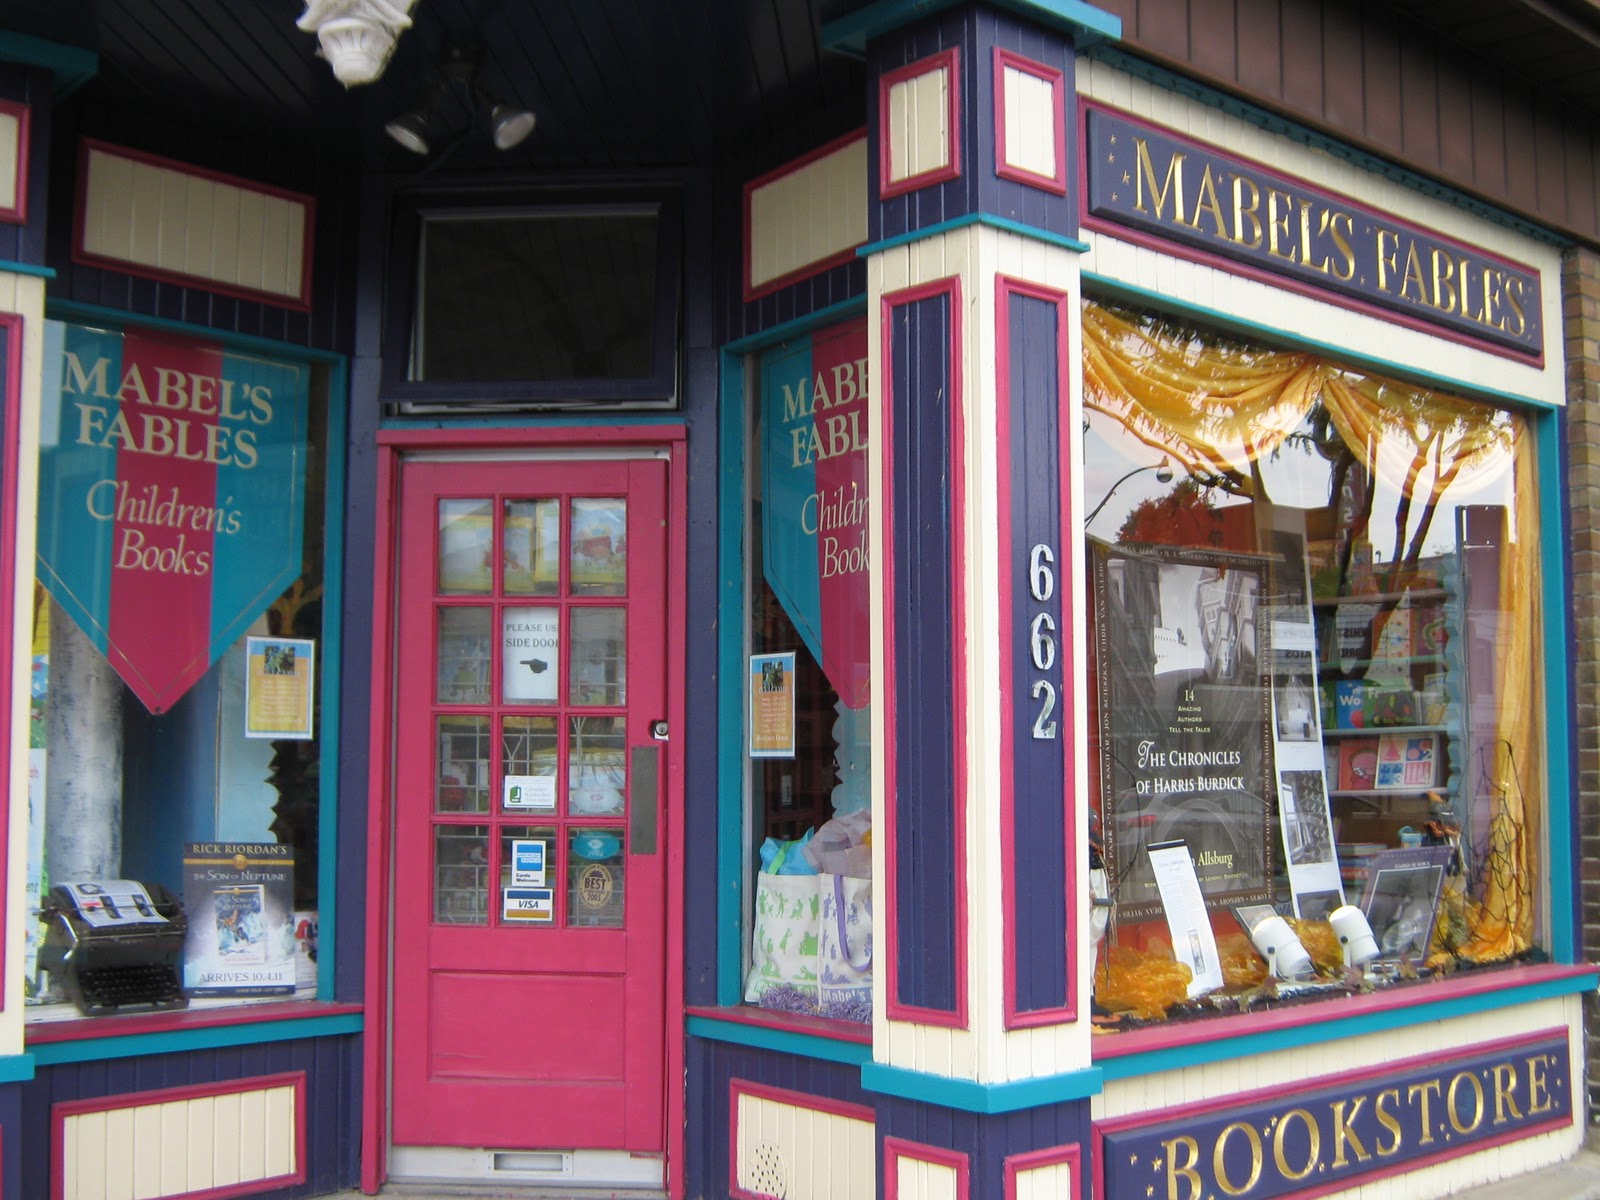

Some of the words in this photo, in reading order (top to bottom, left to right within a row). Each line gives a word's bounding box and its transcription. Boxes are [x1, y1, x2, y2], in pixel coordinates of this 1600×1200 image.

[1132, 136, 1355, 281] MABEL'S
[1375, 225, 1526, 337] FABLES
[62, 351, 273, 424] MABEL'S
[75, 402, 258, 469] FABLES
[86, 479, 242, 535] Children's
[115, 528, 209, 576] Books
[505, 623, 543, 632] PLEASE
[505, 637, 530, 648] SIDE
[1030, 543, 1057, 739] 662
[1185, 690, 1195, 702] 14
[1138, 740, 1166, 768] THE
[1169, 750, 1241, 767] CHRONICLES
[1136, 780, 1151, 794] OF
[1154, 777, 1195, 794] HARRIS
[1197, 776, 1245, 792] BURDICK
[192, 844, 222, 854] RICK
[225, 844, 288, 855] RIORDAN'S
[1197, 850, 1234, 868] Allsburg
[207, 869, 230, 881] SON
[241, 870, 287, 881] NEPTUNE
[584, 877, 606, 890] BEST
[518, 900, 539, 909] VISA
[200, 973, 249, 983] ARRIVES
[252, 972, 282, 982] 10.4.11
[1161, 1055, 1549, 1200] BOOKSTORE
